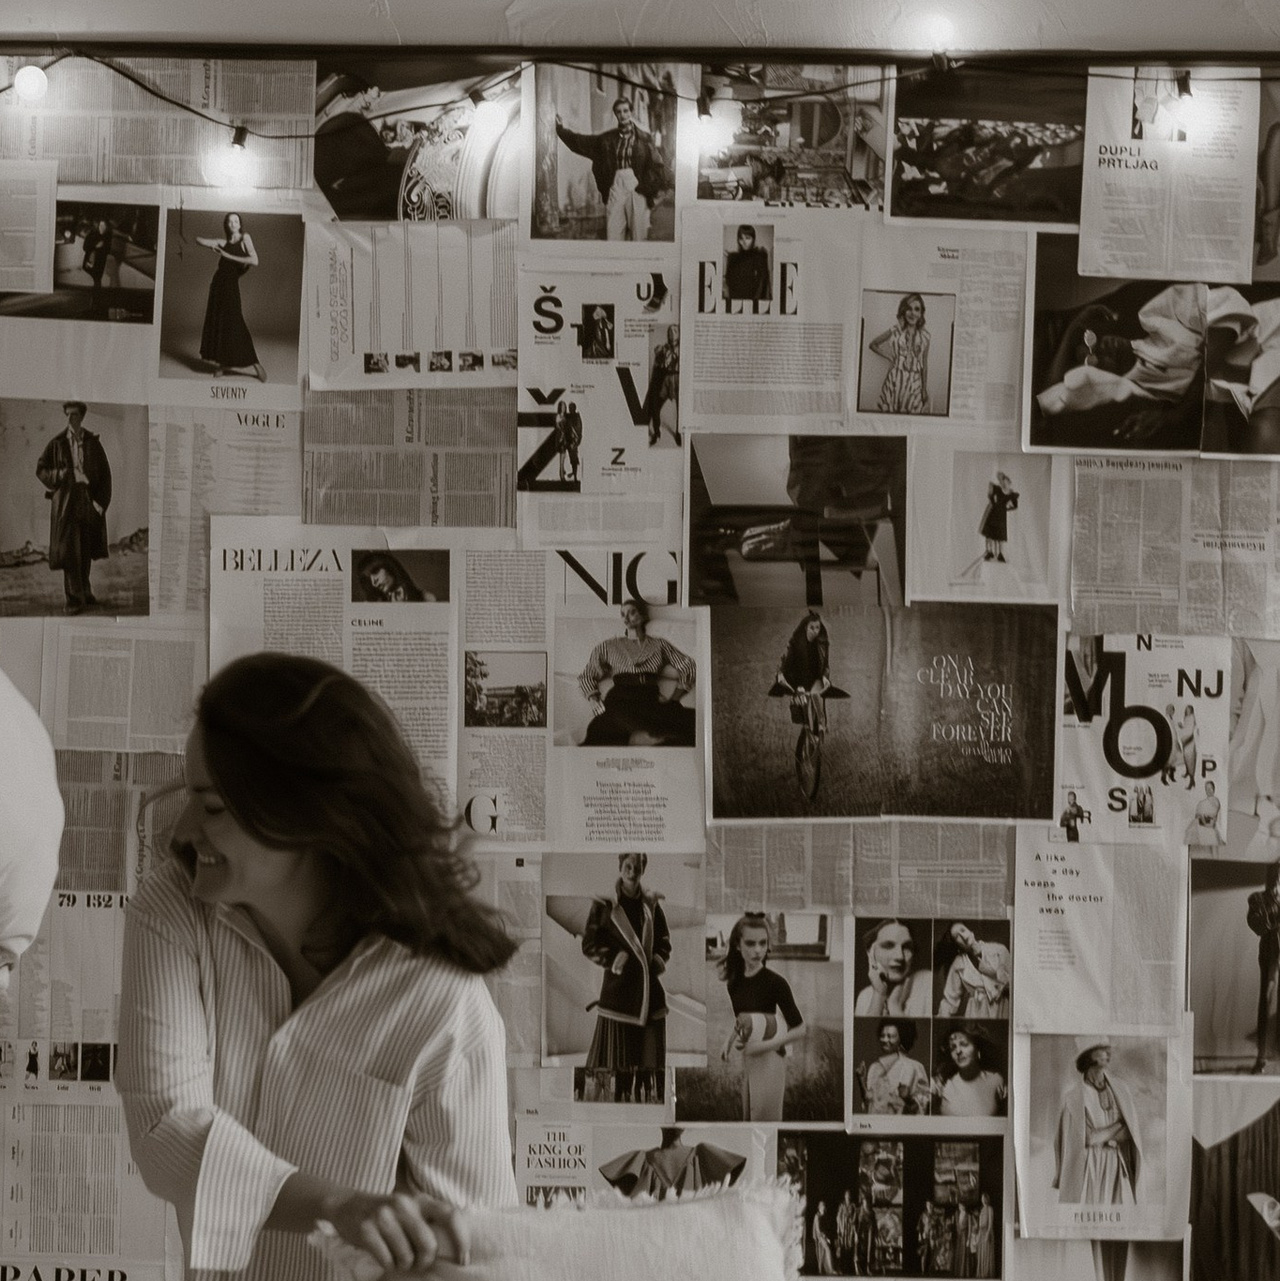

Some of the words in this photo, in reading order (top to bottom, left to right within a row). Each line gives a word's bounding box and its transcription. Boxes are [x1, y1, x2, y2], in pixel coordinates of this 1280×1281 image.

[1098, 144, 1142, 157] DUPLI
[531, 284, 565, 335] Š
[209, 386, 248, 400] SEVENTY
[236, 412, 286, 429] VOGUE
[609, 446, 627, 467] Z
[222, 548, 344, 573] BELLEZA
[350, 618, 384, 628] CELINE
[1136, 632, 1153, 652] N
[1176, 668, 1224, 700] NJ
[931, 723, 1012, 742] FOREVER
[465, 794, 499, 835] G
[1046, 853, 1067, 863] like
[1061, 867, 1081, 878] day
[57, 892, 77, 909] 79
[85, 893, 113, 909] 132
[1047, 892, 1064, 902] the
[1067, 893, 1104, 903] doctor
[1038, 906, 1066, 916] away
[527, 1143, 563, 1156] KING
[566, 1143, 587, 1156] OF
[526, 1156, 588, 1170] FASHION
